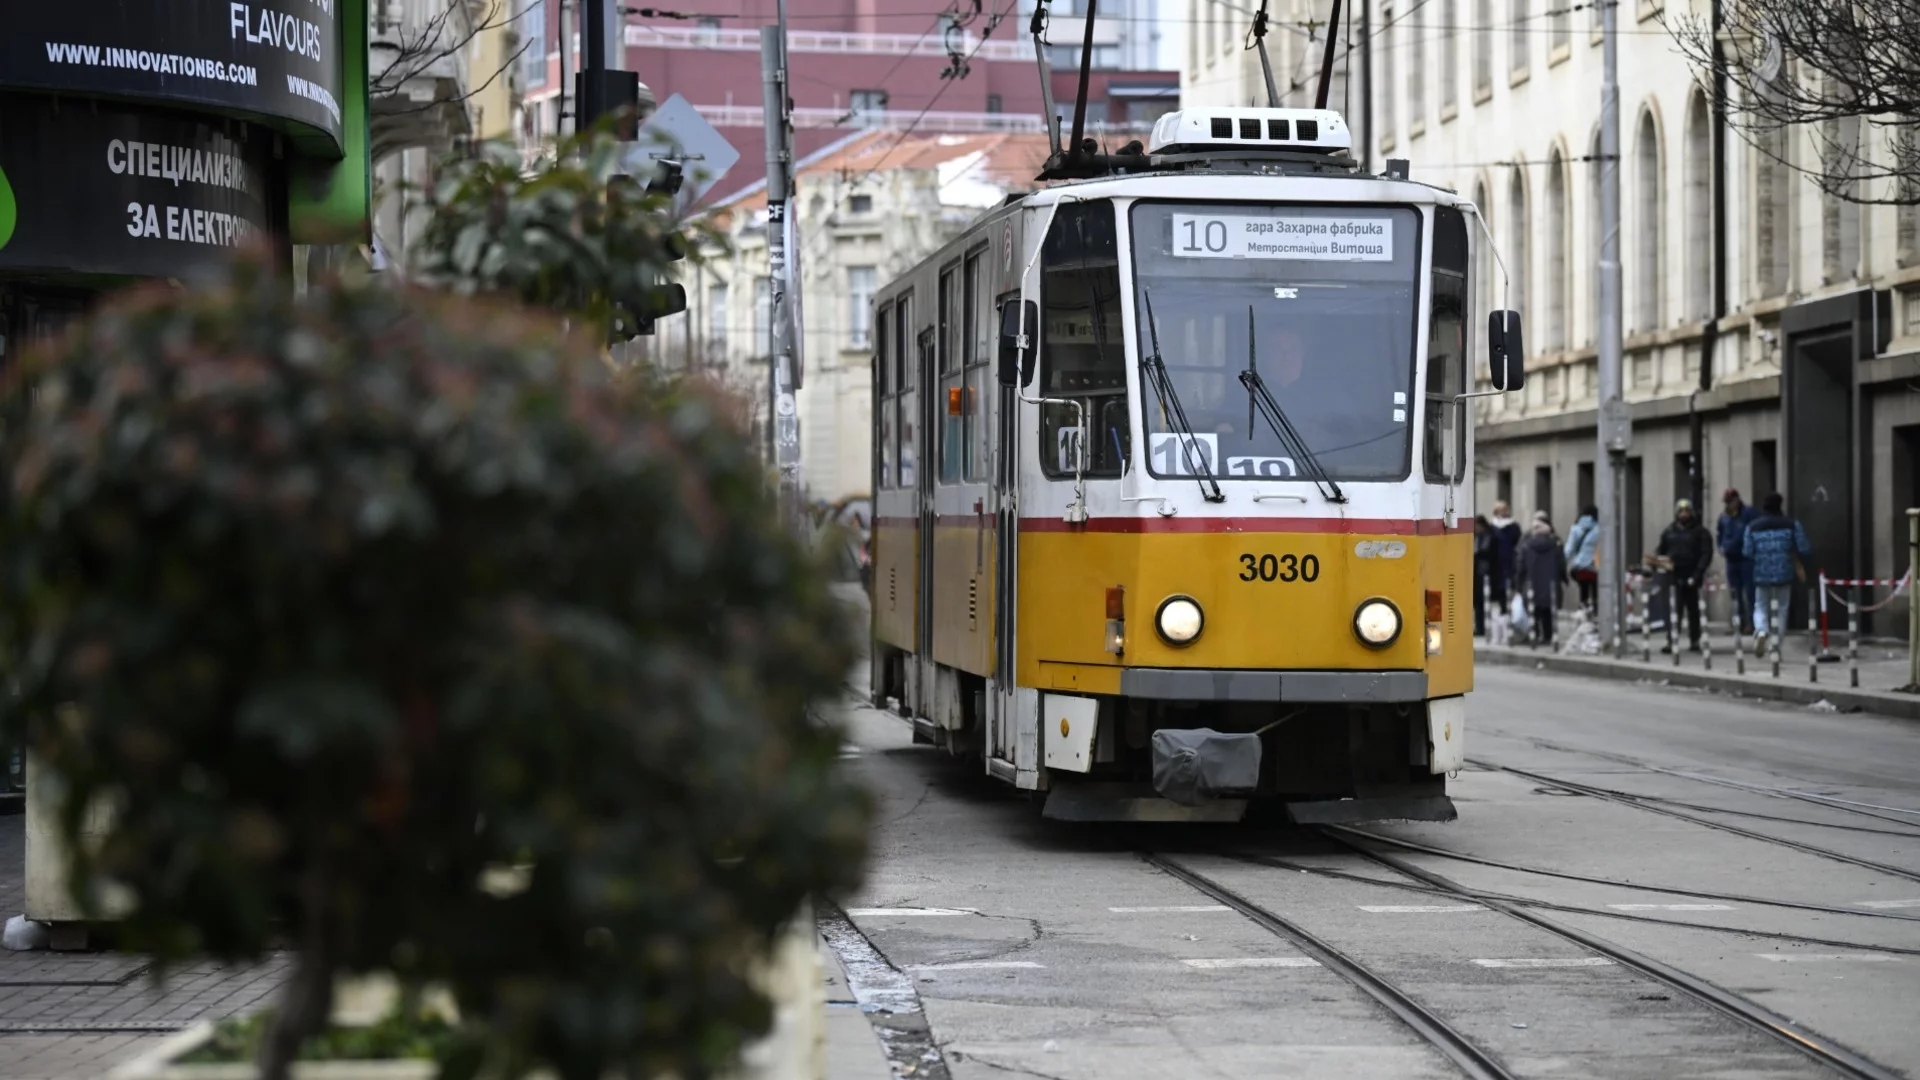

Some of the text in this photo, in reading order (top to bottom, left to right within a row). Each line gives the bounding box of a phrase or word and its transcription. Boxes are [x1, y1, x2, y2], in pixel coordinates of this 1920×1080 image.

[230, 2, 320, 62] FLAVOURS
[46, 42, 257, 86] WWW.INNOVATIONBG.COM
[127, 202, 161, 238] ЗА
[1183, 220, 1383, 252] 10 гара Захарна фабрика
[1247, 242, 1383, 254] Метростанция Витоша
[1154, 437, 1213, 475] 10
[1239, 554, 1320, 582] 3030
